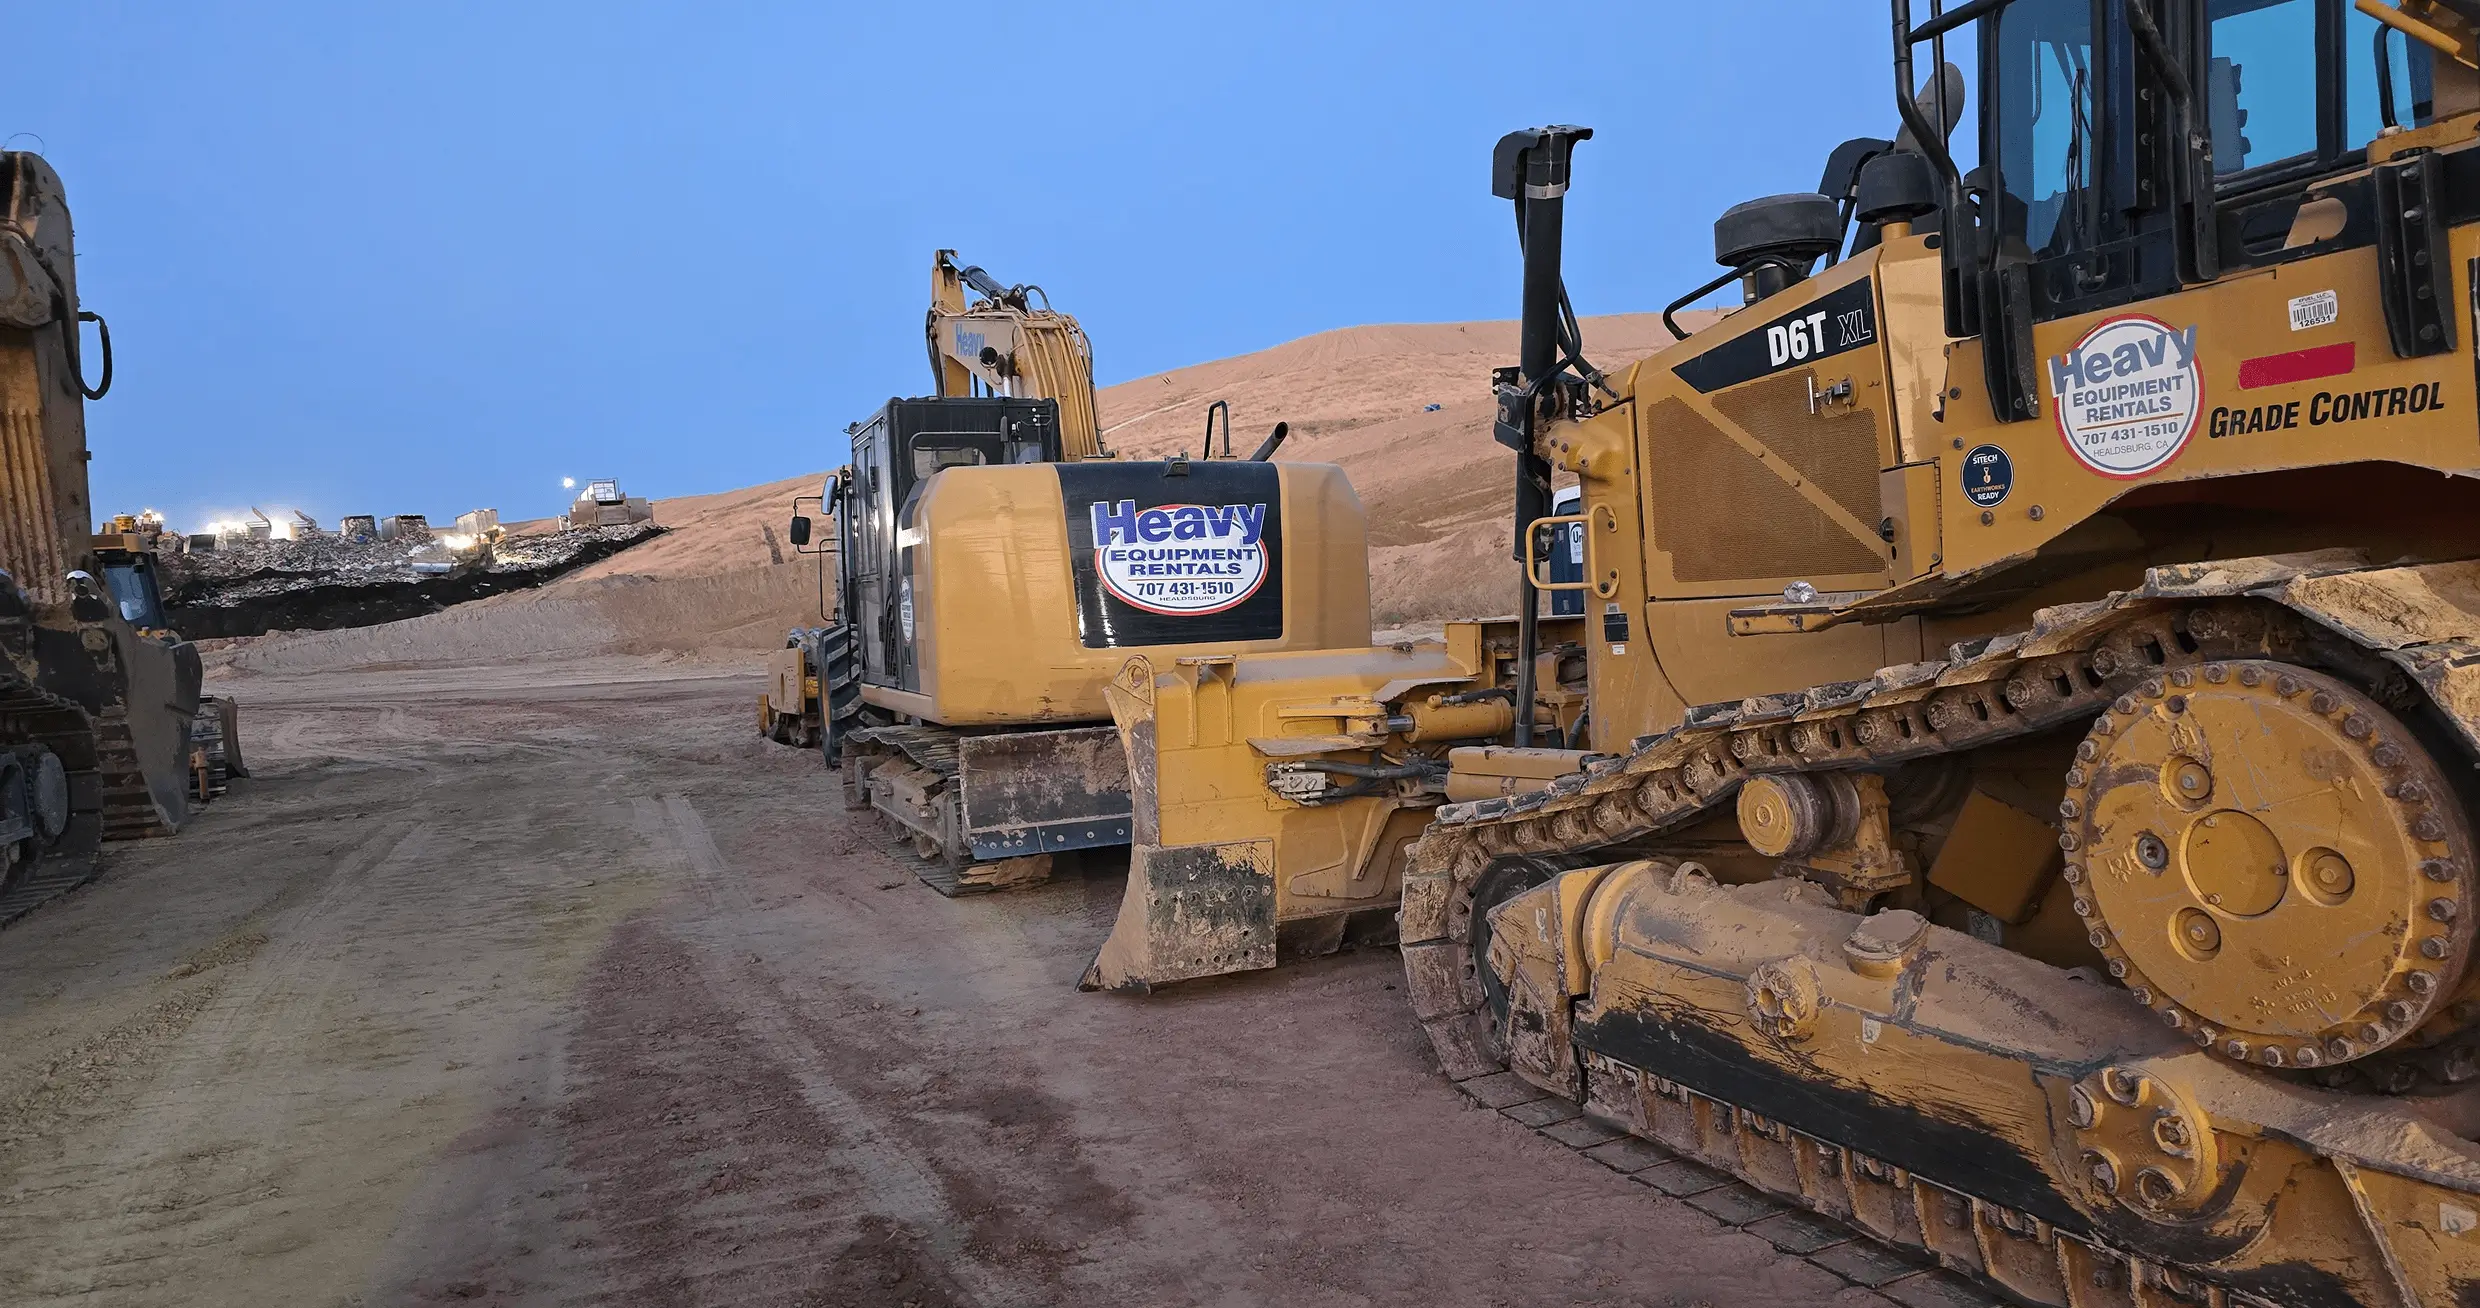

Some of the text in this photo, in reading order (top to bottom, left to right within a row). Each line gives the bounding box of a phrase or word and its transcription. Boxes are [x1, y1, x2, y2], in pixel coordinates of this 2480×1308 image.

[2300, 315, 2331, 327] 126531
[1767, 308, 1872, 367] D6T XL
[2048, 324, 2199, 396] Heavy
[2072, 375, 2185, 408] EQUIPMENT
[2085, 396, 2173, 424] RENTALS
[2082, 421, 2179, 446] 707 431-1510
[2156, 439, 2170, 450] CA
[1973, 454, 1998, 464] SITECH
[1971, 484, 2005, 493] EARTHWORKS
[1978, 491, 1999, 500] READY
[1090, 499, 1267, 548] Heavy
[1110, 548, 1257, 563] EQUIPMENT
[1129, 562, 1243, 577] RENTALS
[1136, 581, 1234, 596] 707 431-1510
